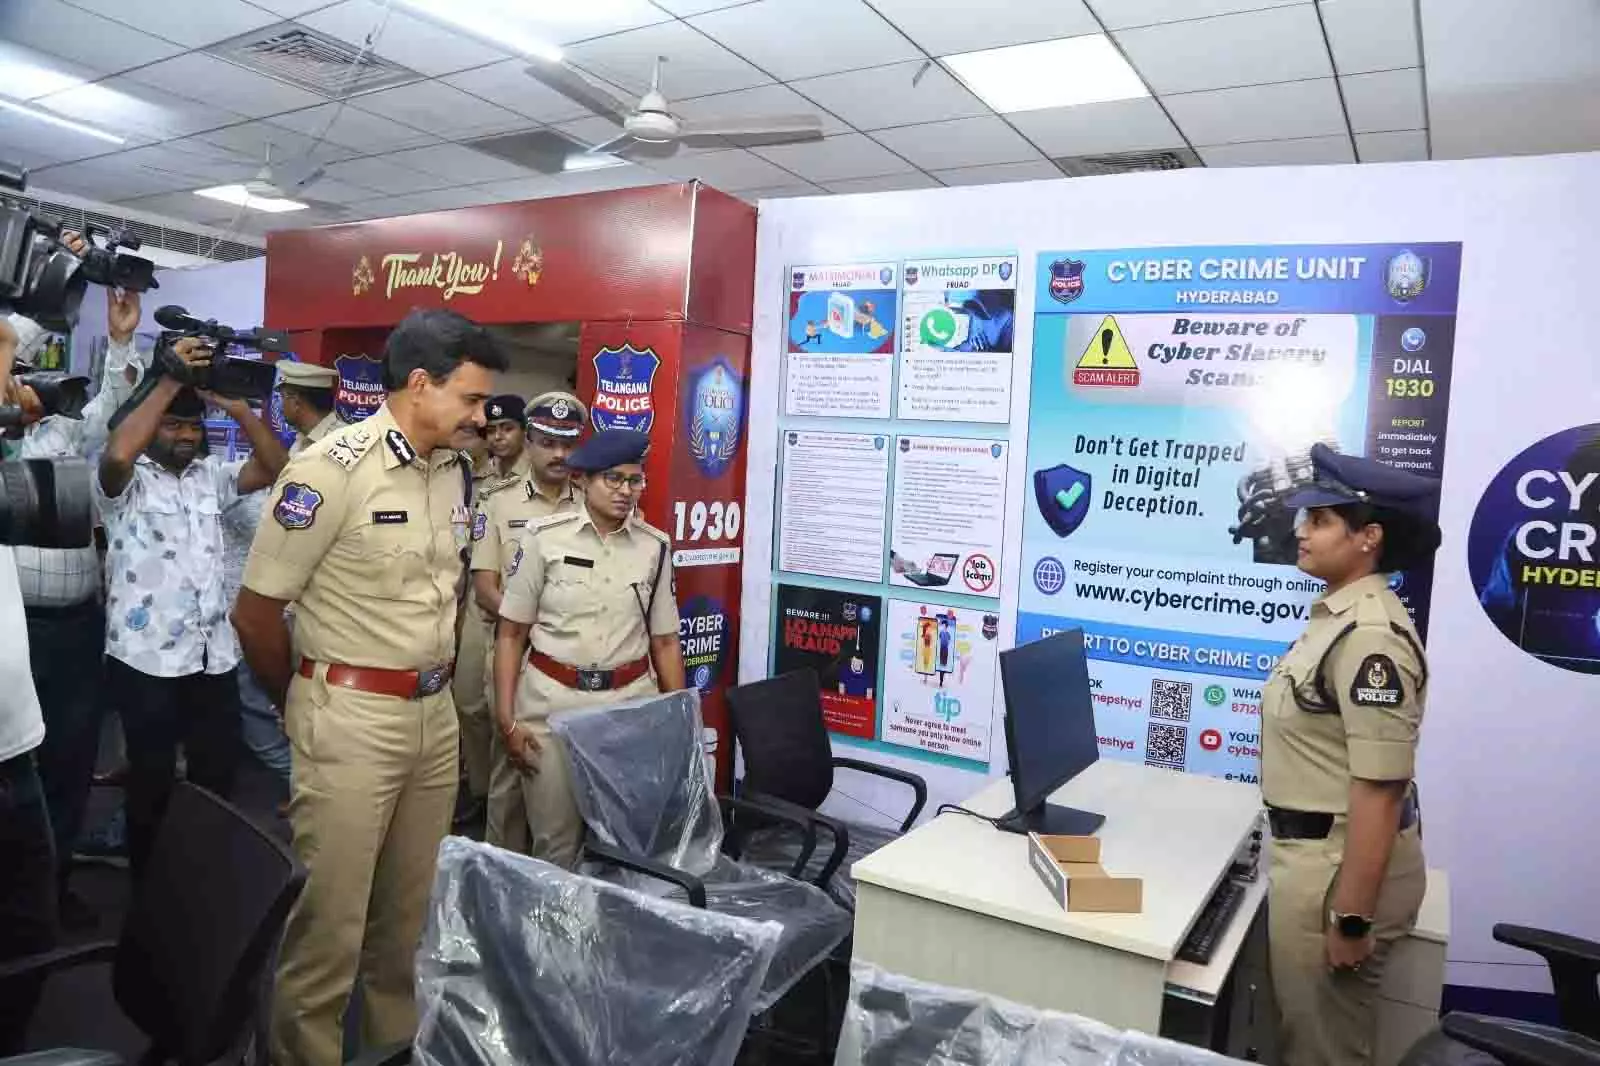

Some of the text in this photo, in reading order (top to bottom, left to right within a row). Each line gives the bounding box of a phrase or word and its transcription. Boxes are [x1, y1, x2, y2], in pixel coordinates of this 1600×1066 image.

[381, 252, 446, 299] Thank
[921, 263, 979, 278] Whatsapp
[1107, 256, 1367, 283] CYBER CRIME UNIT
[1175, 289, 1280, 305] HYDERABAD
[1172, 318, 1306, 337] Beware of
[1147, 342, 1220, 364] Cyber
[1393, 359, 1433, 375] DIAL
[342, 379, 384, 392] TELANGANA
[1077, 371, 1137, 384] SCAM ALERT
[600, 379, 648, 394] TELANGANA
[1386, 379, 1434, 398] 1930
[339, 390, 385, 405] POLICE
[596, 393, 651, 413] POLICE
[1378, 432, 1437, 444] immediately
[1074, 434, 1246, 464] Don't Get Trapped
[1391, 447, 1407, 456] get
[1409, 447, 1432, 455] back
[1112, 464, 1200, 490] in Digital
[1515, 469, 1600, 514] CY
[1103, 491, 1204, 519] Deception.
[673, 501, 741, 542] 1930
[1515, 520, 1597, 562] CR
[1074, 559, 1328, 594] Register your complaint through online
[1522, 565, 1600, 588] HYDE
[786, 608, 820, 620] BEWARE
[679, 614, 724, 635] CYBER
[1042, 627, 1104, 651] RRT
[1108, 636, 1131, 654] TO
[1134, 640, 1191, 662] CYBER
[1195, 647, 1252, 669] CRIME
[1088, 679, 1103, 689] OK
[1233, 688, 1262, 700] WHA
[1358, 693, 1397, 703] POLICE
[934, 691, 961, 721] tip
[1090, 693, 1143, 712] mepshyd
[1231, 703, 1261, 715] 8712
[905, 715, 922, 726] Never
[924, 721, 941, 731] agree
[1096, 736, 1135, 751] eshyd
[1229, 732, 1260, 745] YOUT
[1227, 745, 1260, 758] cybe
[1225, 773, 1260, 785] e-MA
